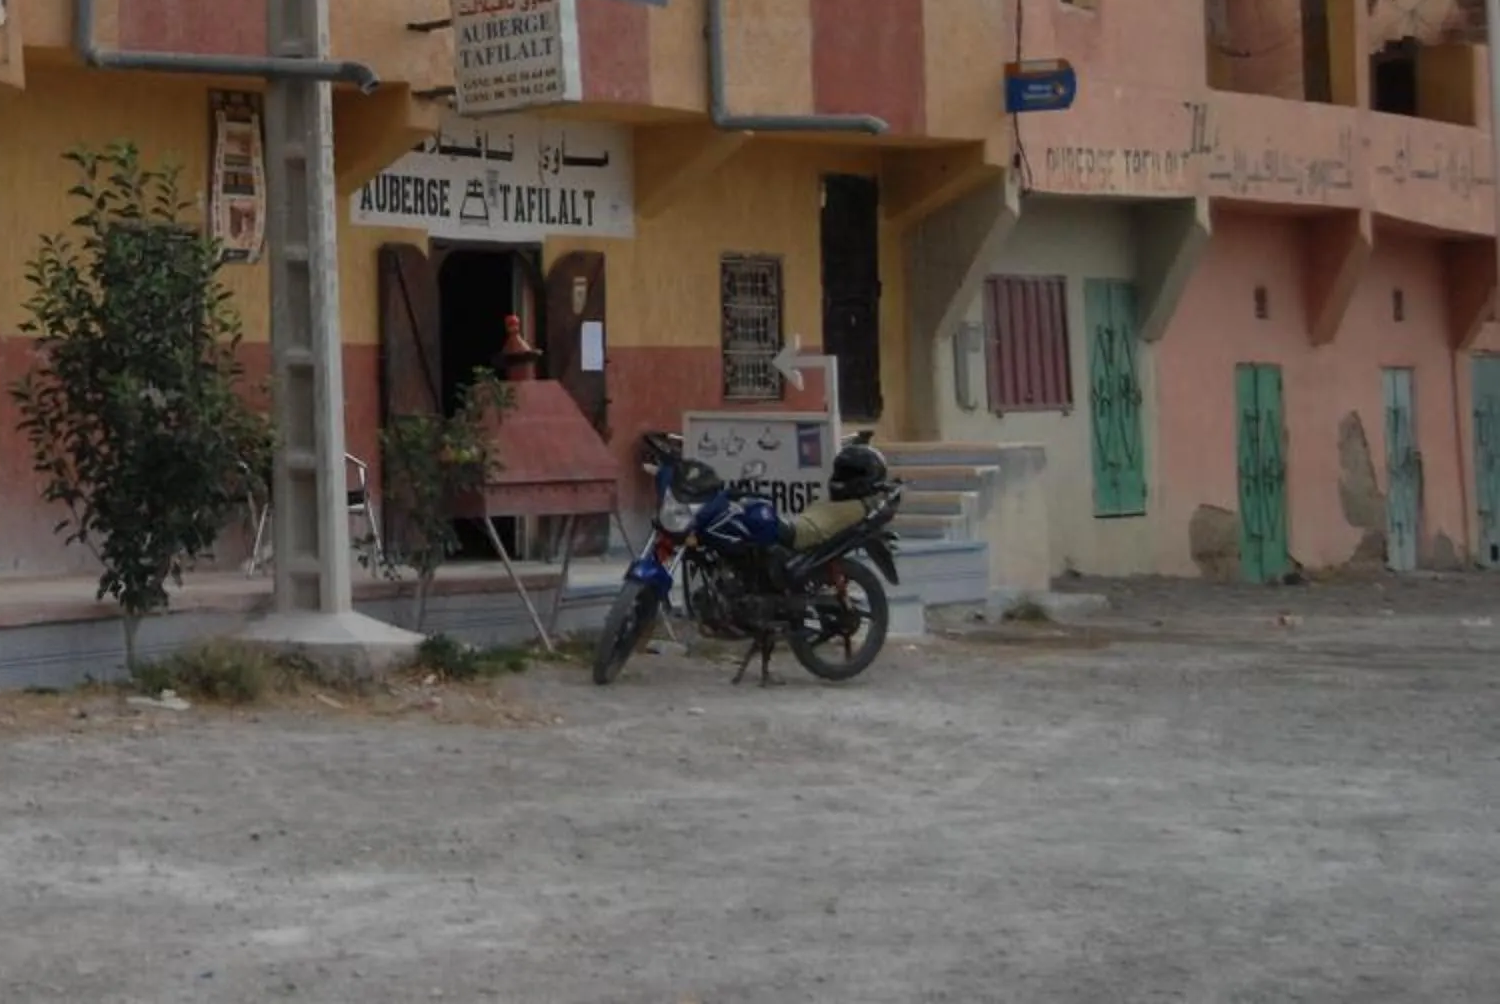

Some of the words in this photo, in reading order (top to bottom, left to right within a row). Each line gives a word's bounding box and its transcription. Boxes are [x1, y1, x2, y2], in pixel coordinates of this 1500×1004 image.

[462, 13, 551, 44] AUBERGE
[460, 37, 552, 68] TAFILALT
[359, 174, 451, 217] AUBERGE
[499, 183, 596, 226] TAFILALT
